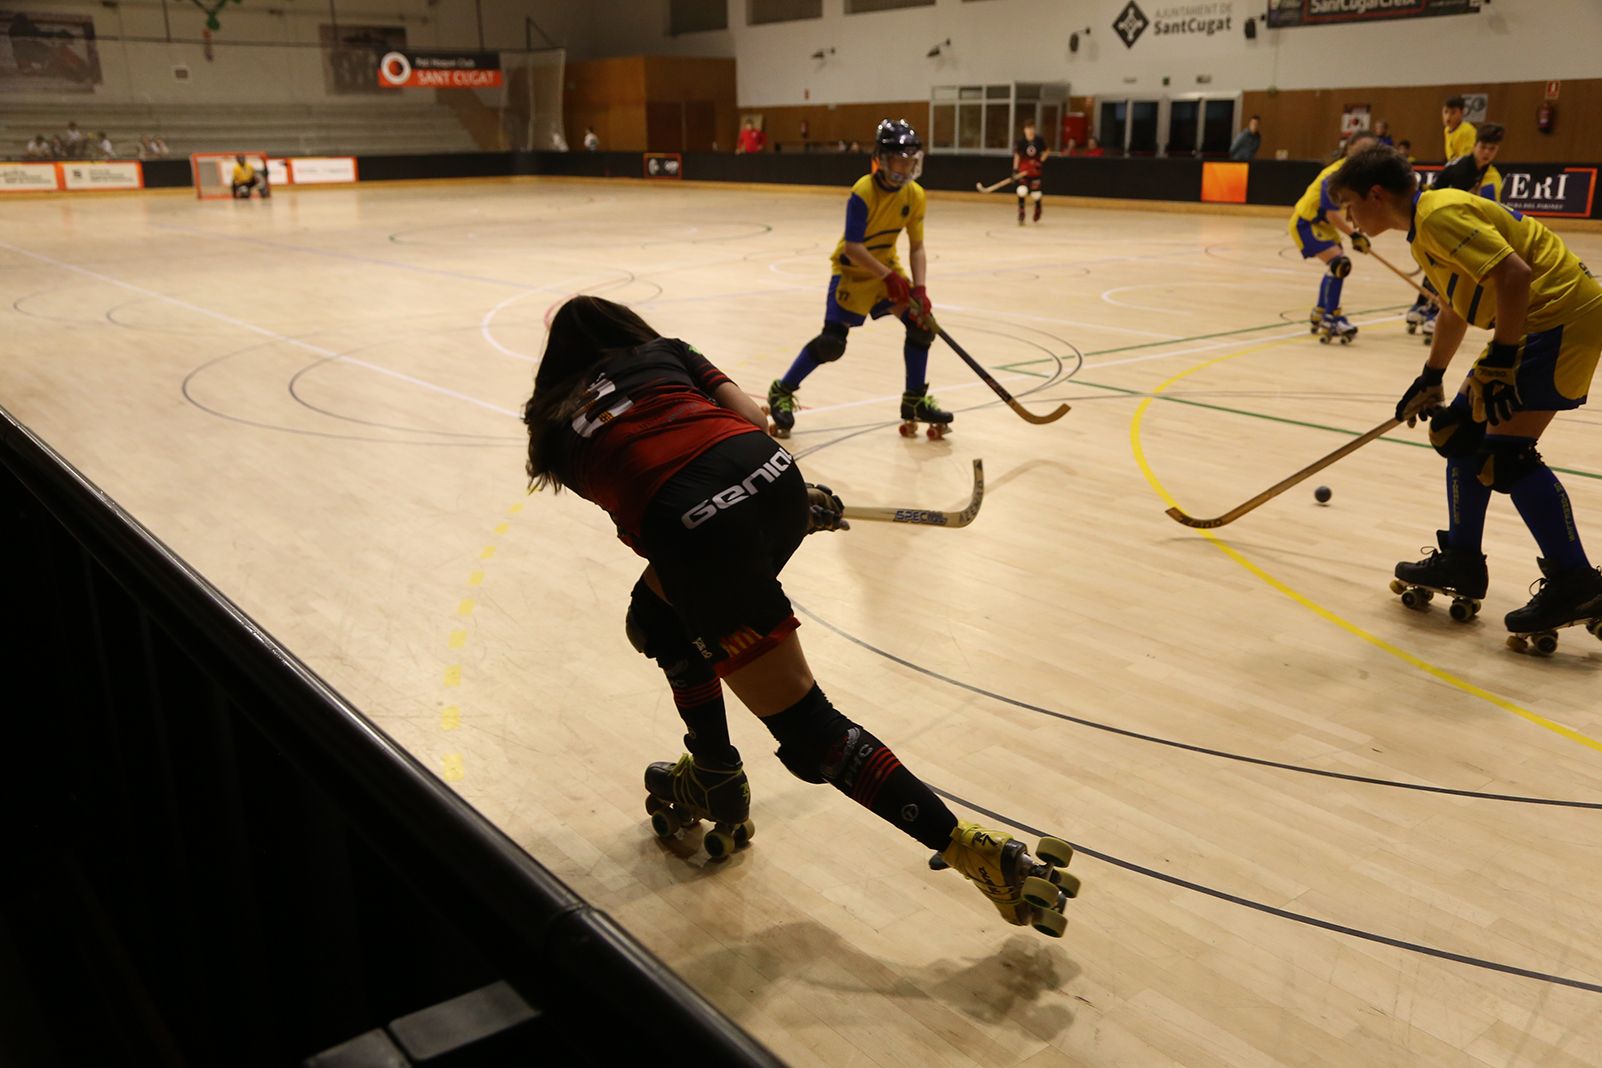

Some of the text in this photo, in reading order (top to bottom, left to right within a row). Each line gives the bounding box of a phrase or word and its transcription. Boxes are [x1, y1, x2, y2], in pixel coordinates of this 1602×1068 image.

[1154, 16, 1232, 36] SantCugat
[416, 70, 495, 86] SANT CUGAT
